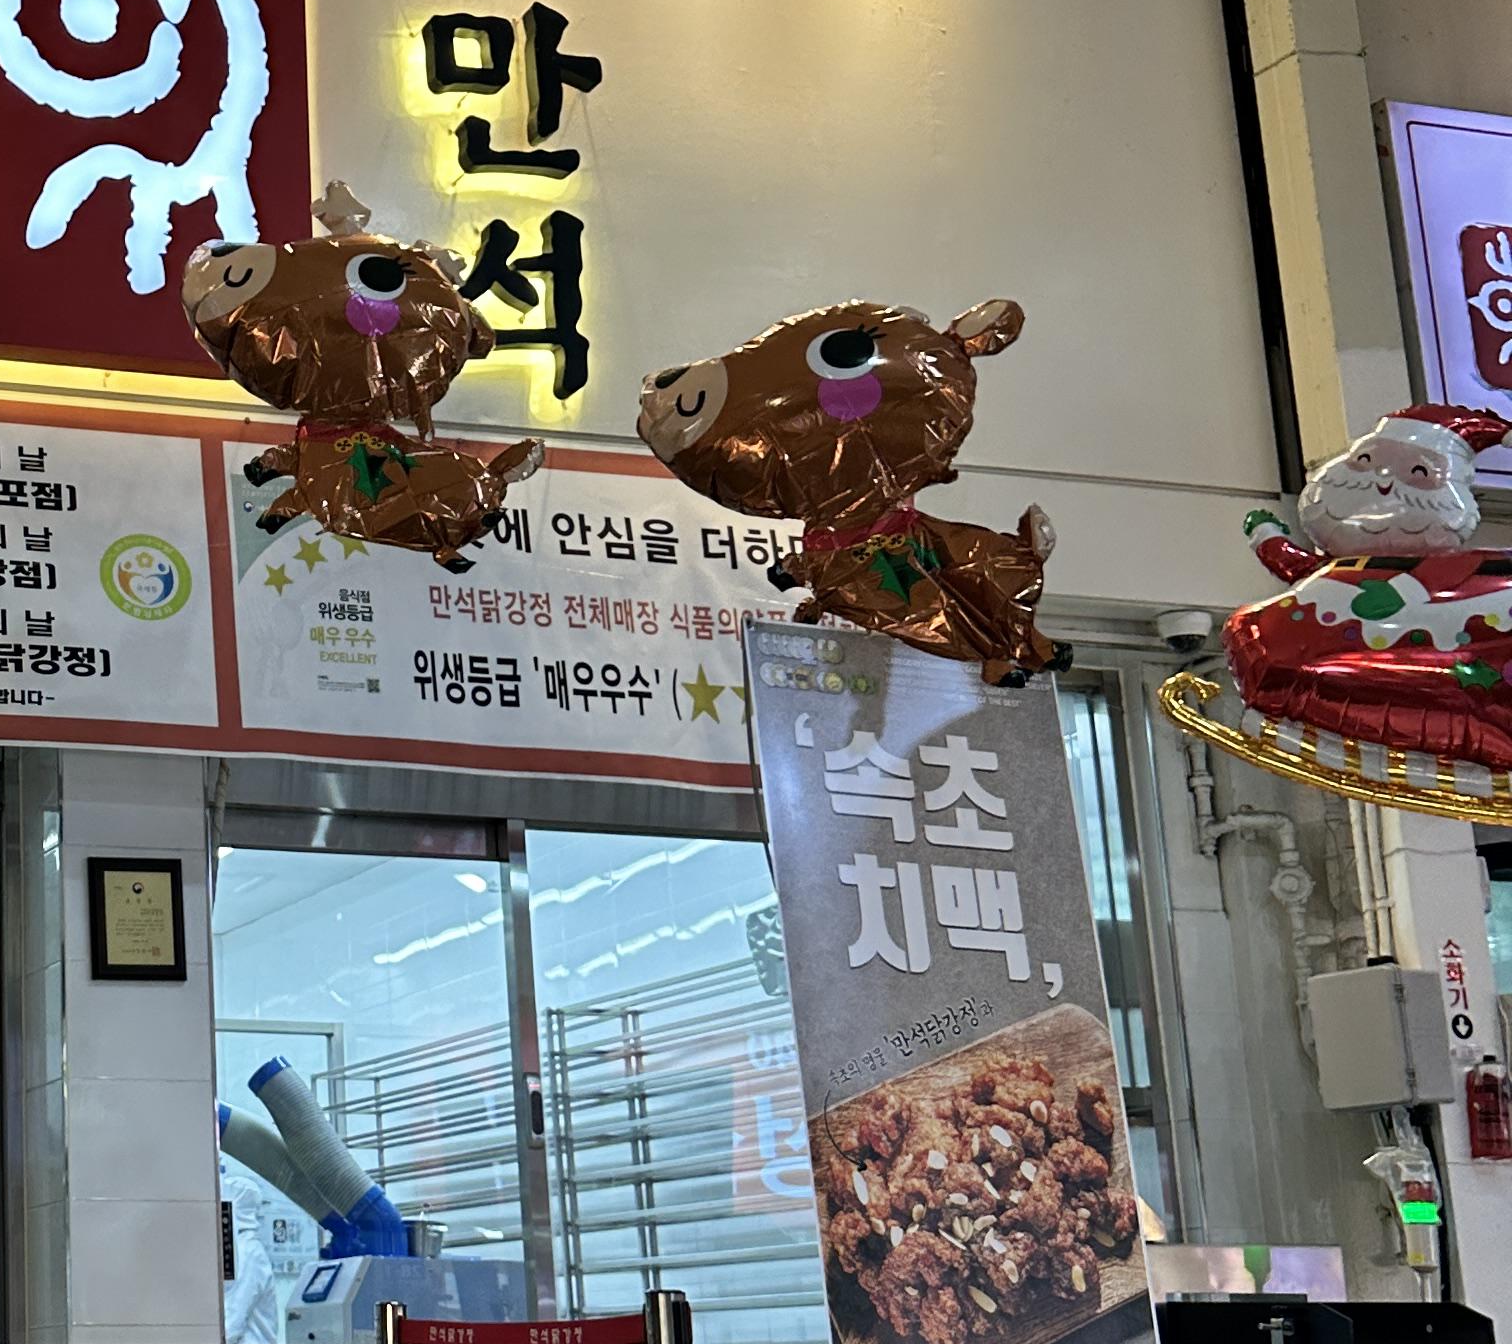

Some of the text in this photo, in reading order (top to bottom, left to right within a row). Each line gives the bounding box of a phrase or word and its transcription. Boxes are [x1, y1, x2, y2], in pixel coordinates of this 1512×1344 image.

[422, 1, 603, 401] 만석
[17, 445, 48, 472] 날
[23, 526, 53, 553] 날
[551, 512, 679, 565] 안심을
[25, 609, 56, 637] 날
[318, 601, 374, 622] 위생등급
[429, 584, 553, 627] 만석닭강정
[564, 594, 660, 635] 전체매장
[414, 650, 521, 707] 위생등급
[1443, 939, 1469, 1010] 소화기
